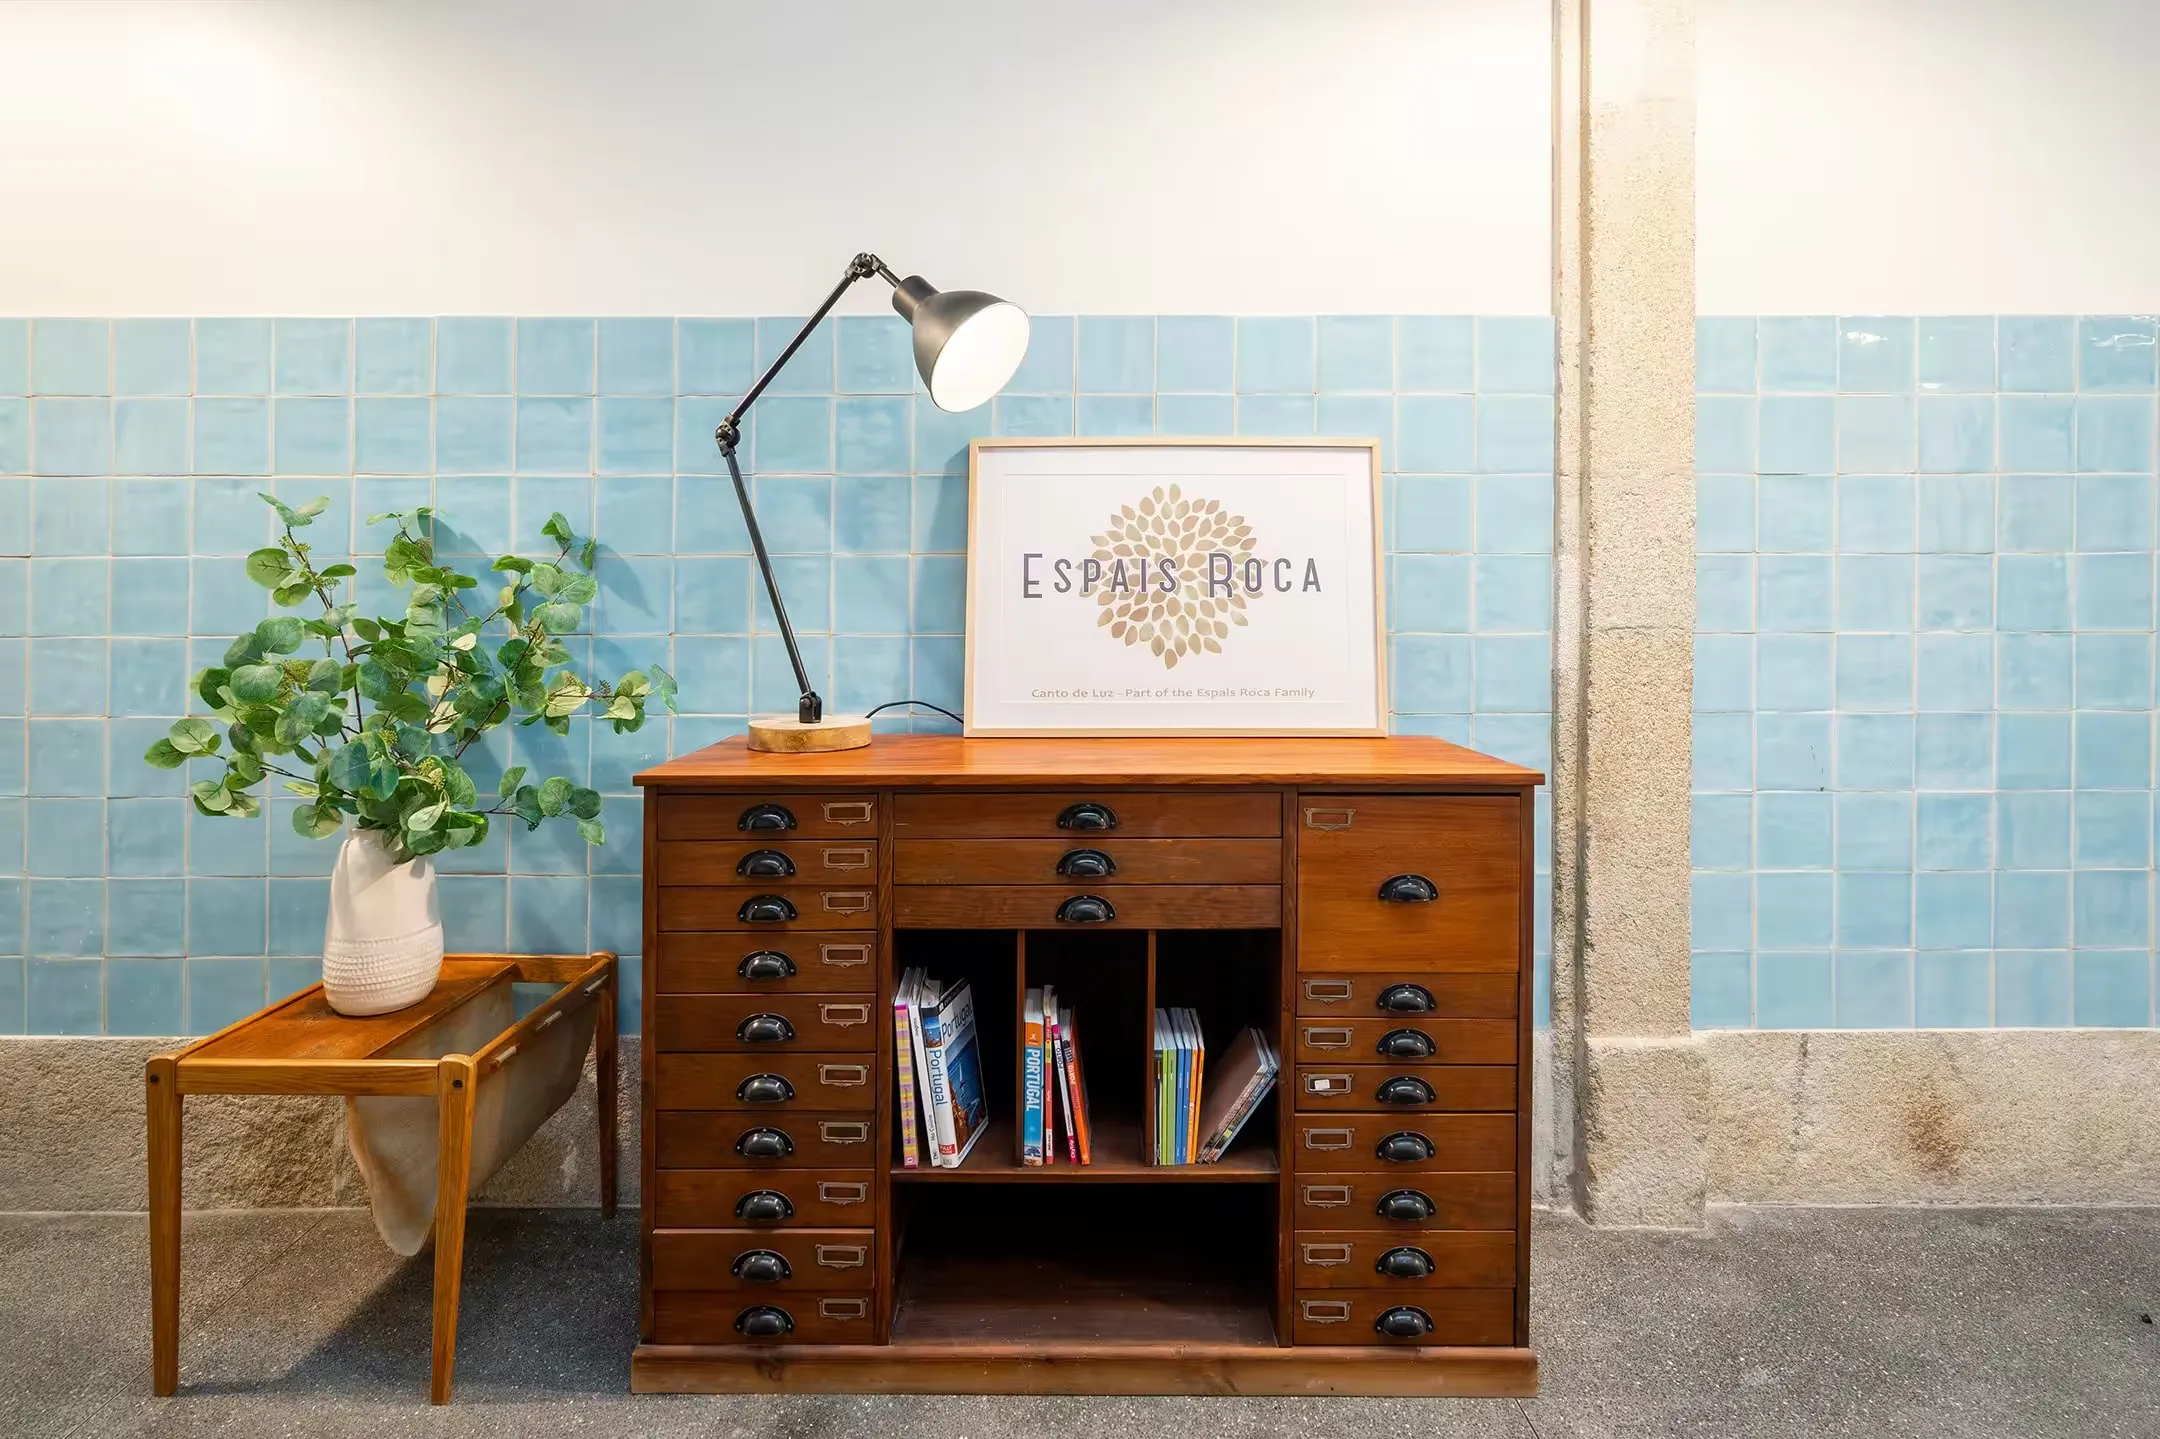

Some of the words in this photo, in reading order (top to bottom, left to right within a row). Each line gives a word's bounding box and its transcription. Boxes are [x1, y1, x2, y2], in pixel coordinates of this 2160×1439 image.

[1031, 688, 1069, 698] Canto
[1072, 688, 1089, 698] de
[1092, 688, 1114, 698] Luz
[1125, 688, 1151, 697] Part
[1155, 687, 1169, 697] of
[1171, 687, 1193, 697] the
[1197, 687, 1236, 699] Espais
[1240, 687, 1270, 697] Roca
[1274, 687, 1316, 699] Family
[941, 1003, 973, 1044] Portugal
[929, 1049, 948, 1106] Portugal
[1055, 1047, 1064, 1069] PORTO
[1026, 1048, 1040, 1112] PORTUGAL
